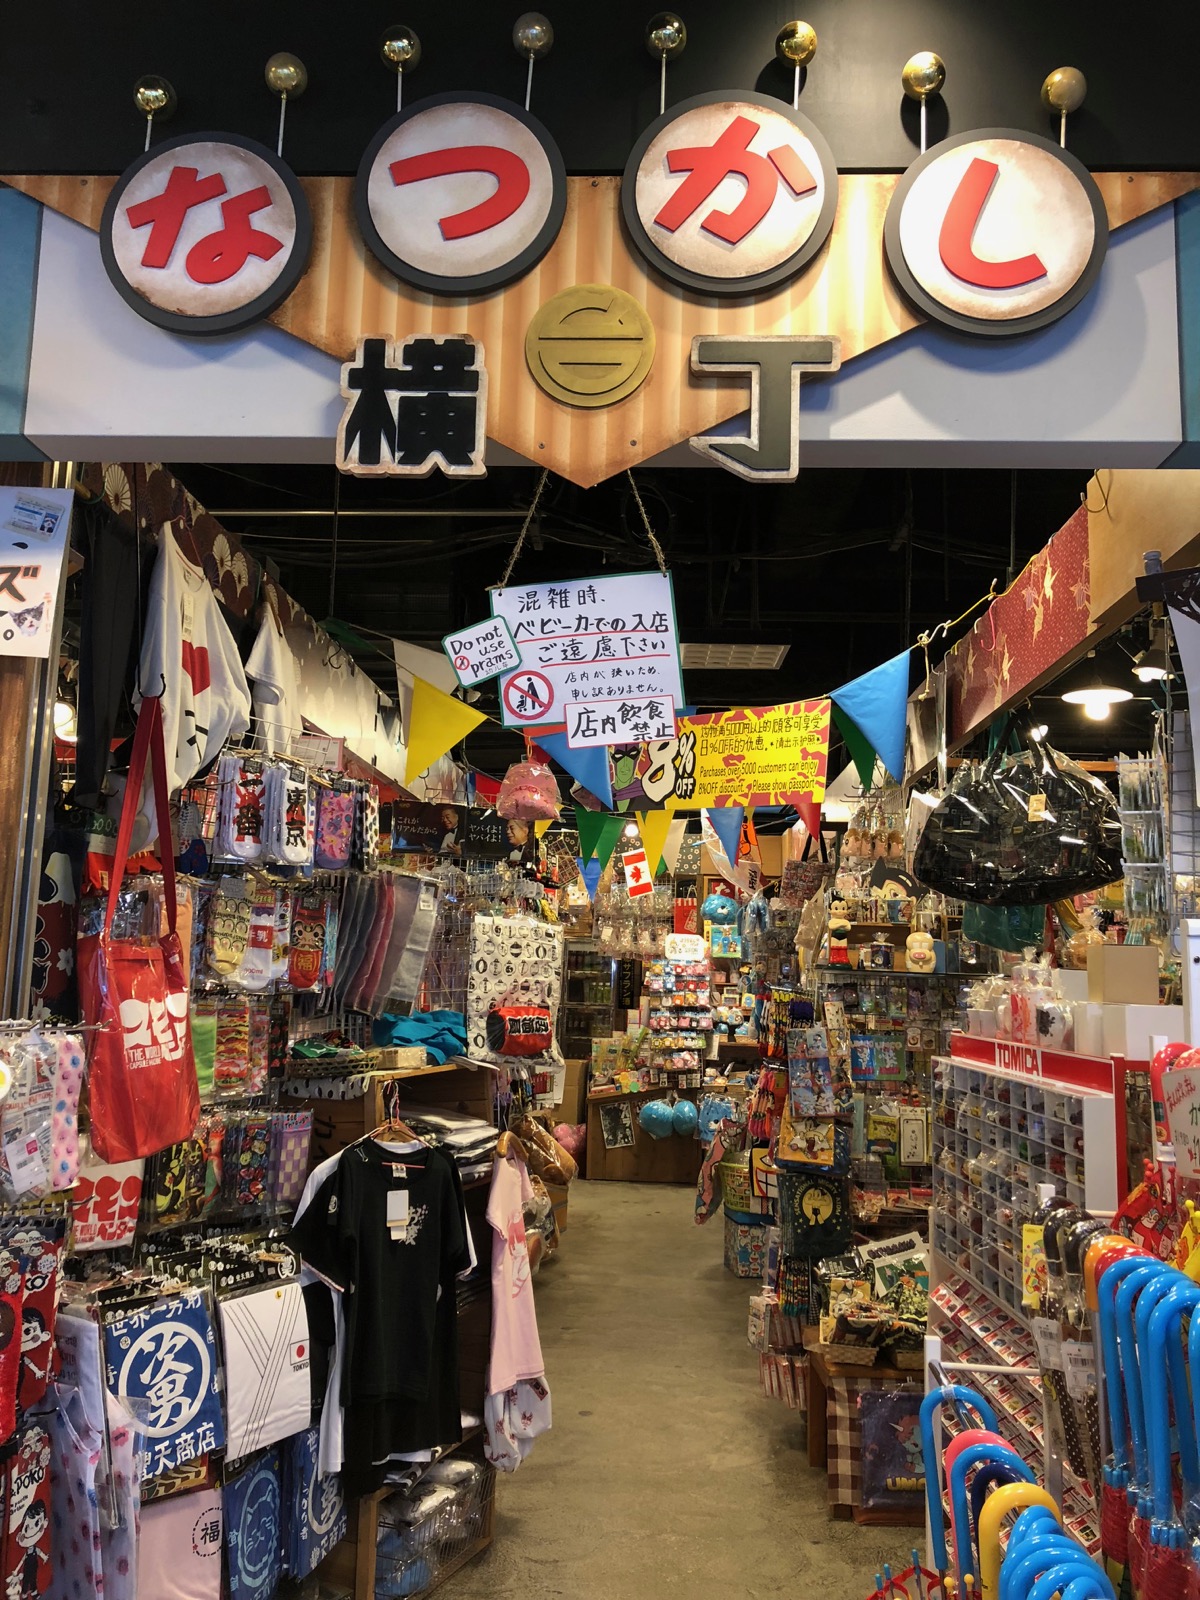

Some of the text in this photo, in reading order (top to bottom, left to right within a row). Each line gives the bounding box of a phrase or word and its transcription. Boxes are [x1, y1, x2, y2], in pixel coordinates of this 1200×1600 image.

[126, 115, 1047, 290] なつかし
[518, 584, 605, 613] 混雑時、
[450, 625, 502, 655] Do not
[479, 640, 505, 656] use
[538, 636, 666, 663] ご遠慮下さい
[471, 649, 513, 678] prams
[571, 683, 664, 699] 申し訳ありません。
[571, 700, 664, 739] 店内飲食
[629, 721, 675, 741] 禁止
[757, 763, 787, 774] customers
[788, 762, 800, 771] can
[801, 760, 818, 775] enjoy
[675, 777, 694, 797] OFF
[752, 779, 771, 792] Please
[772, 780, 787, 791] show
[788, 778, 815, 794] passport
[396, 816, 419, 826] これが
[997, 1045, 1040, 1077] TOMICA
[292, 1361, 310, 1373] TOKYO
[14, 1467, 45, 1494] POKO
[200, 1520, 220, 1545] 福
